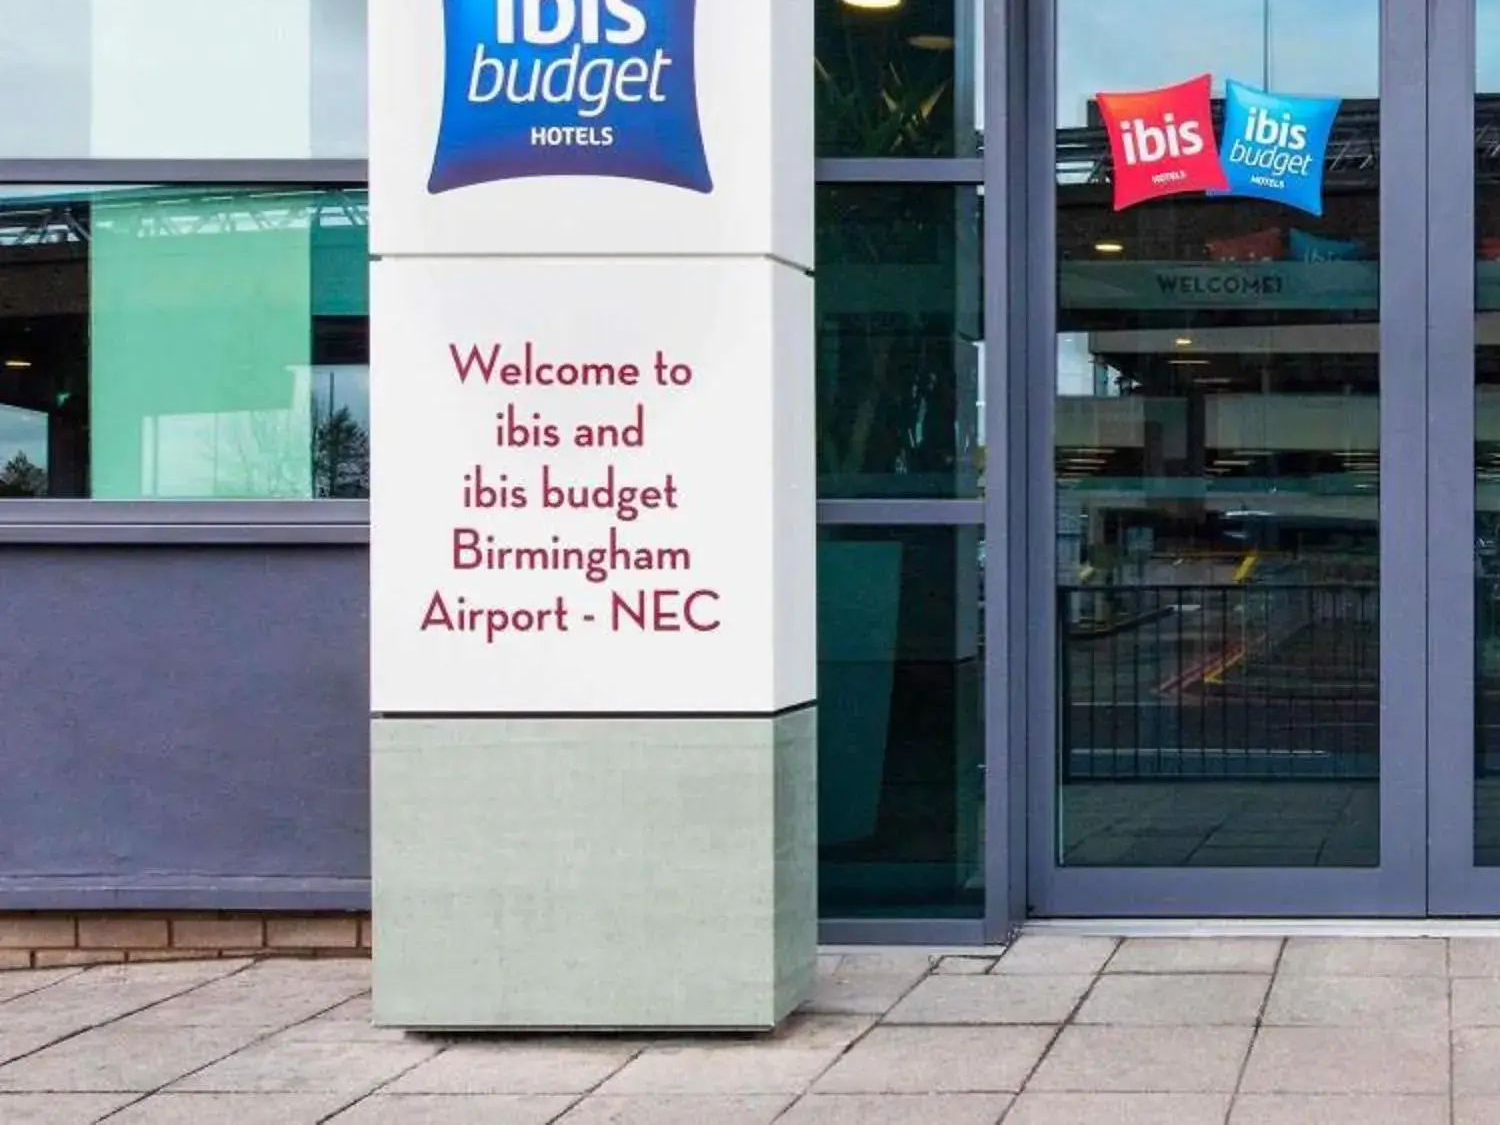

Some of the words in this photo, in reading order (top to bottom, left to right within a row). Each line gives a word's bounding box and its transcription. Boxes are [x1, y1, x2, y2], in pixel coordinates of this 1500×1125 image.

[468, 43, 671, 116] budget
[530, 126, 614, 146] HOTELS
[1120, 113, 1204, 165] ibis
[1244, 107, 1307, 150] ibis
[1229, 138, 1312, 175] budget
[1157, 276, 1283, 295] WELCOME!
[449, 341, 640, 386] Welcome
[654, 350, 693, 386] to
[496, 403, 560, 448] ibis
[573, 403, 644, 448] and
[463, 465, 528, 509] ibis
[542, 465, 678, 522] budget
[452, 527, 692, 583] Birmingham
[420, 590, 568, 643] Airport
[611, 589, 721, 632] NEC
